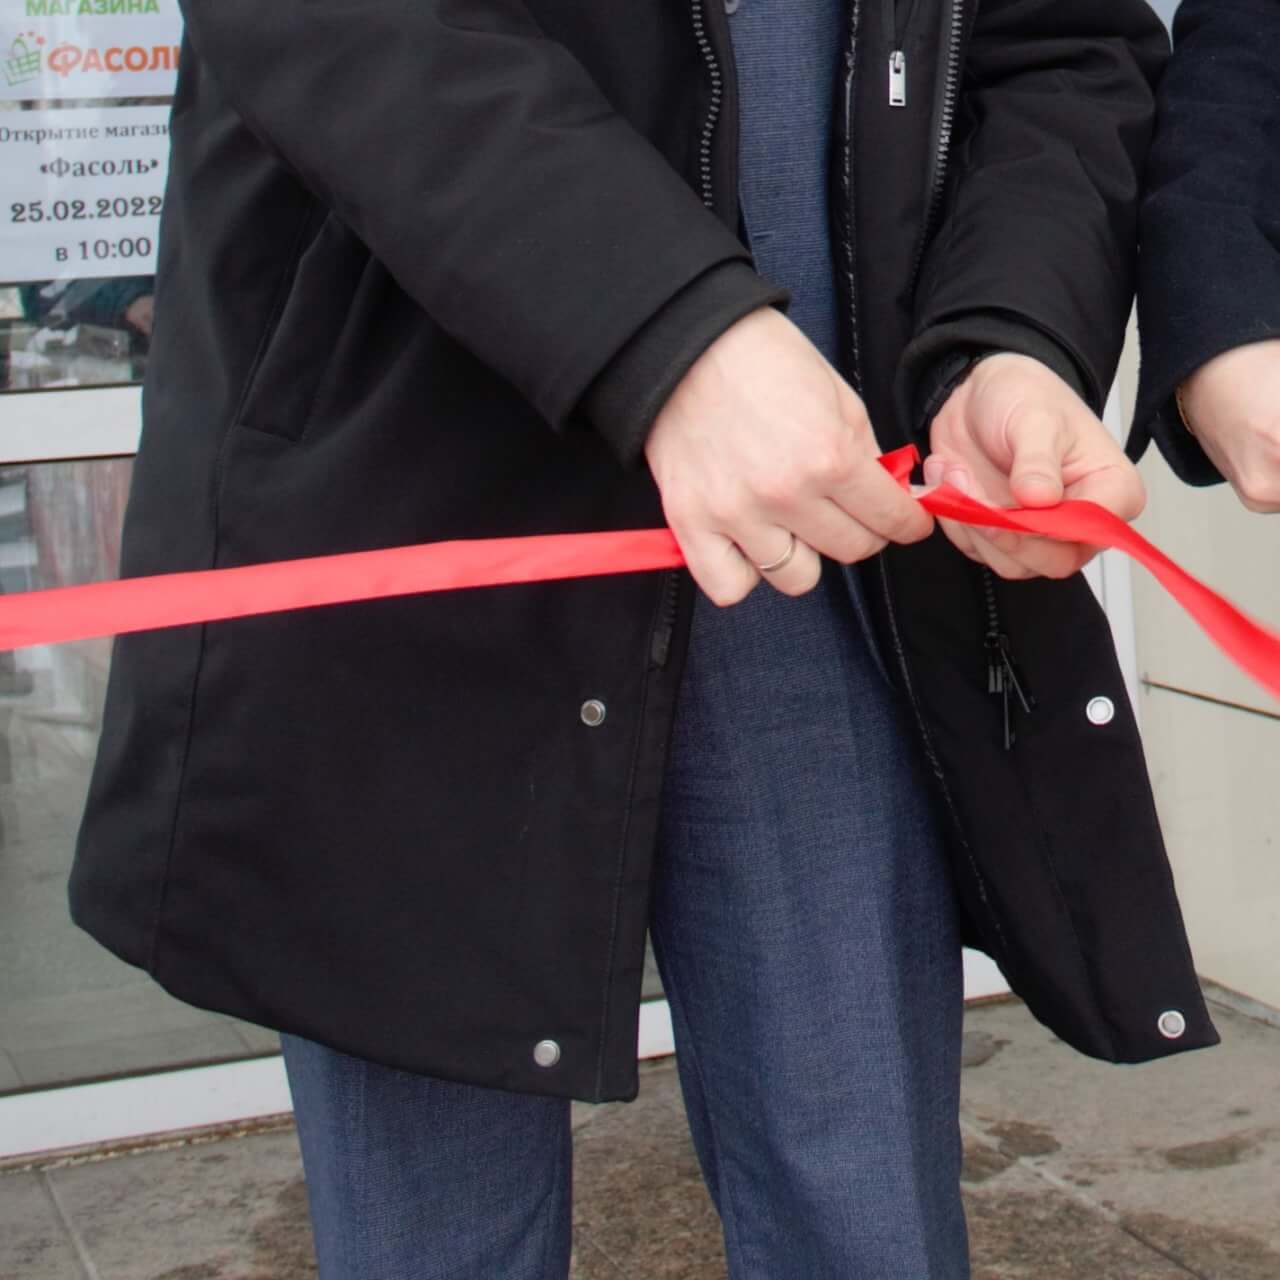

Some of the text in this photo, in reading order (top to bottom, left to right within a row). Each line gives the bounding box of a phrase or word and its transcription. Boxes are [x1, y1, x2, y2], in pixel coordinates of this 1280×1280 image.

[0, 126, 99, 144] Открытие
[11, 196, 162, 223] 25.02.2022
[55, 237, 152, 261] в 10:00
